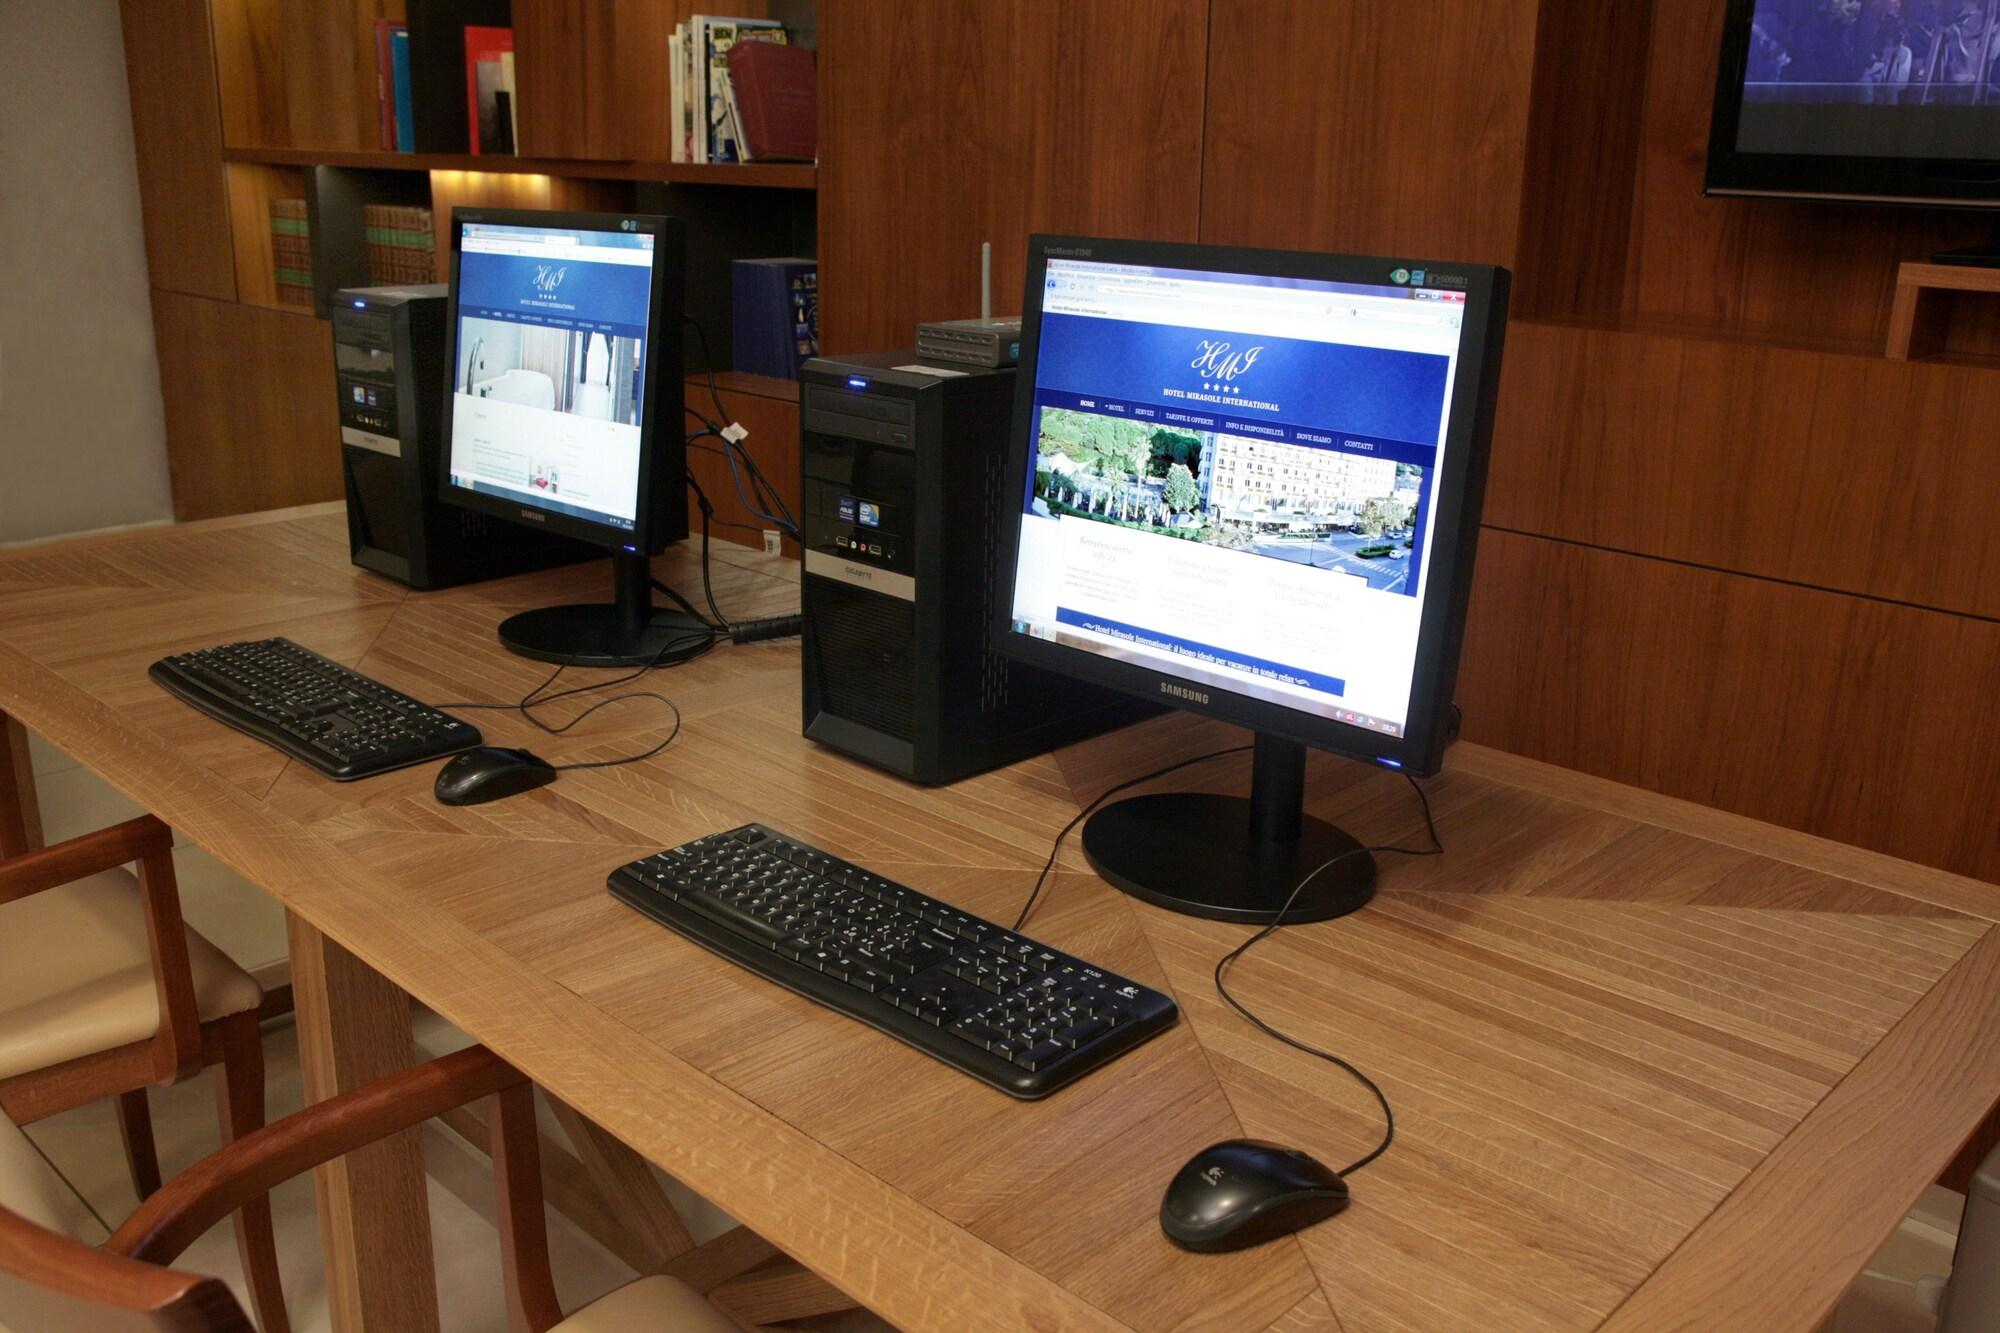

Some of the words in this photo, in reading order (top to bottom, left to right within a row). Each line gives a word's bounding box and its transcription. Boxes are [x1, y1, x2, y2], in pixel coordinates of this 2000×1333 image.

[1080, 399, 1095, 408] HOME
[1163, 388, 1186, 399] HOTEL
[1186, 392, 1221, 403] MIRASOLE
[1222, 397, 1280, 412] INTERNATIONAL
[1108, 404, 1125, 412] HOTEL
[1190, 417, 1214, 426] OFFERTE
[1225, 421, 1239, 430] INFO
[1296, 432, 1313, 441] DOVE
[1312, 435, 1332, 444] SIAMO
[1344, 440, 1374, 451] CONTATTI
[1094, 624, 1110, 635] Hotel
[1110, 628, 1135, 642] Mirasole
[1179, 646, 1197, 659] luogo
[1197, 649, 1215, 664] ideale
[1215, 657, 1226, 666] per
[1227, 660, 1252, 673] vacanze
[1260, 667, 1278, 680] totale
[1278, 673, 1295, 684] relax
[1160, 682, 1209, 705] SAMSUNG
